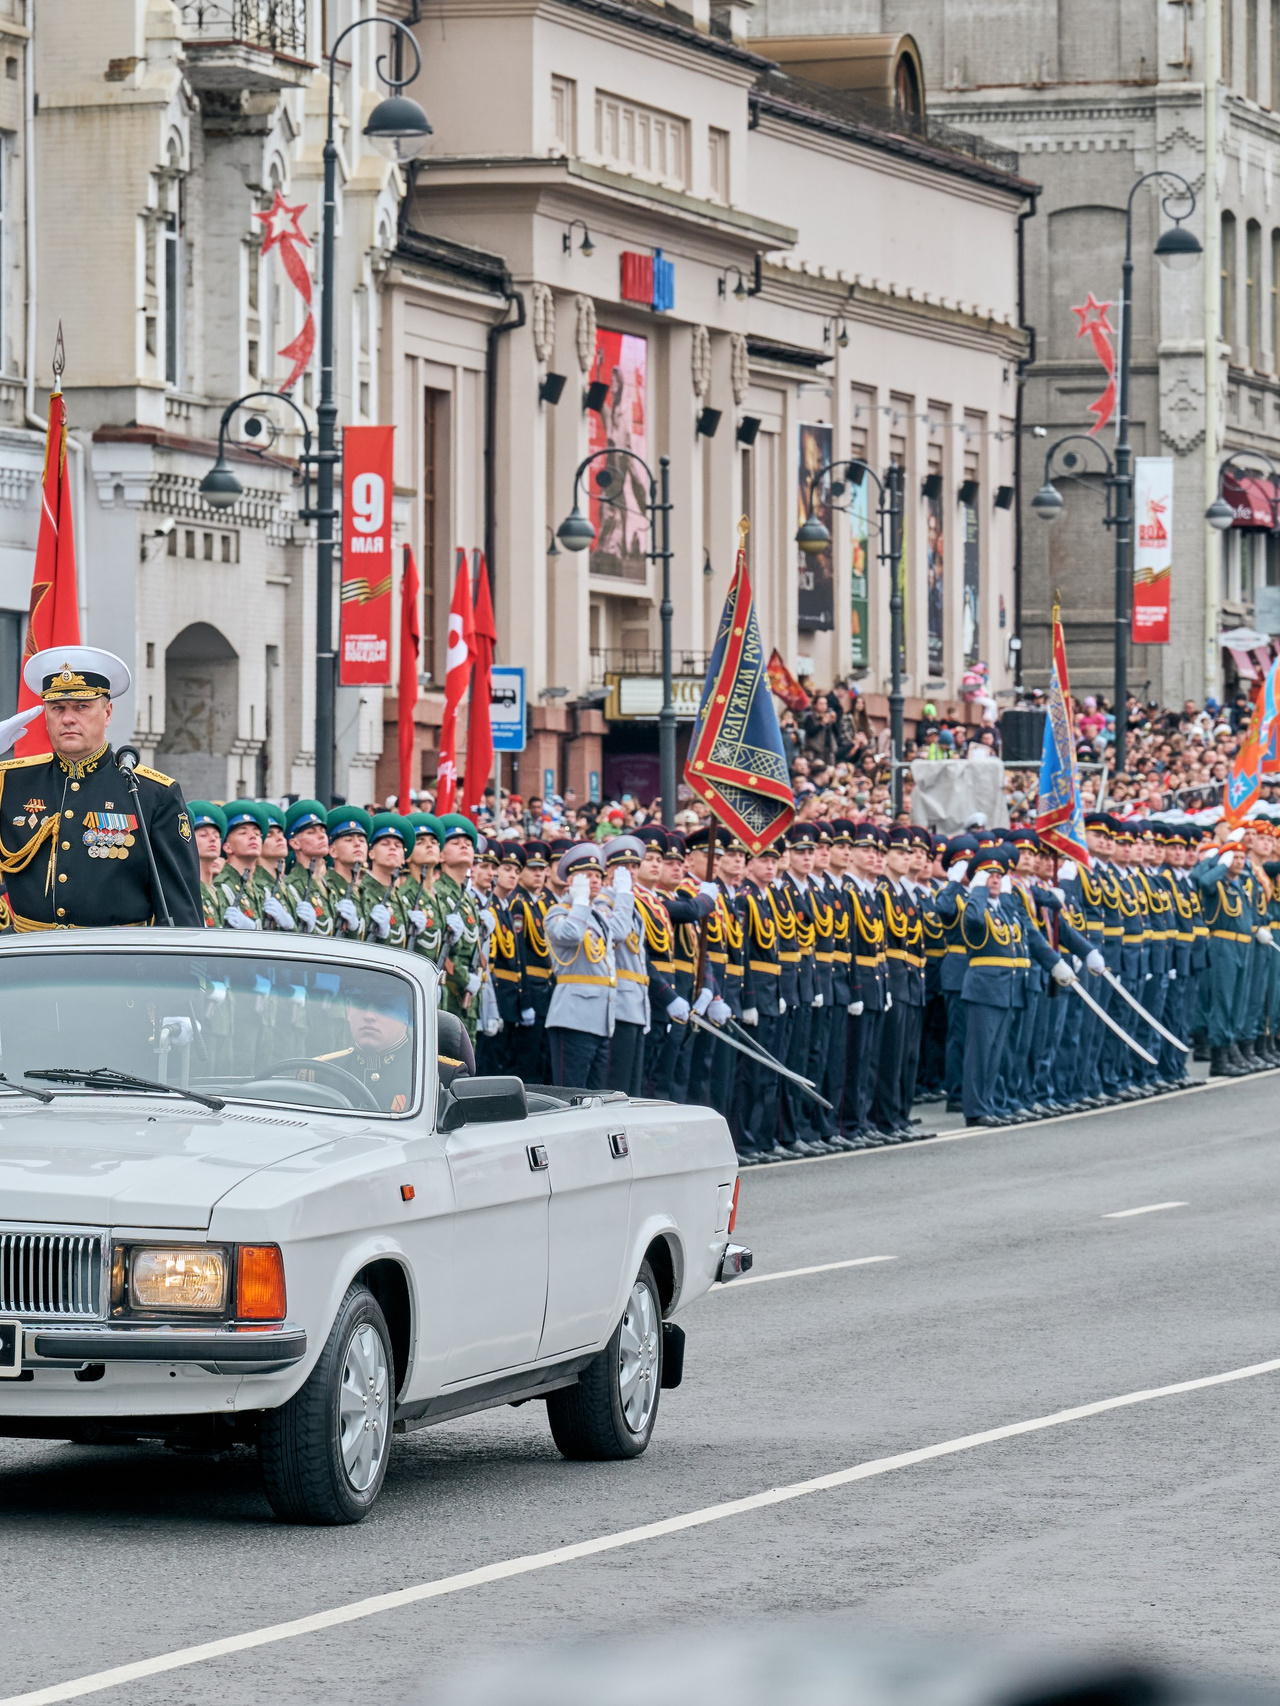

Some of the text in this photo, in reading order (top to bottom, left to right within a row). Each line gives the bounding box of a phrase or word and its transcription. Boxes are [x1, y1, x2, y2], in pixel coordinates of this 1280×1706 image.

[352, 472, 384, 534] 9
[351, 536, 384, 554] МАЯ
[722, 668, 756, 740] СЛУЖИМ
